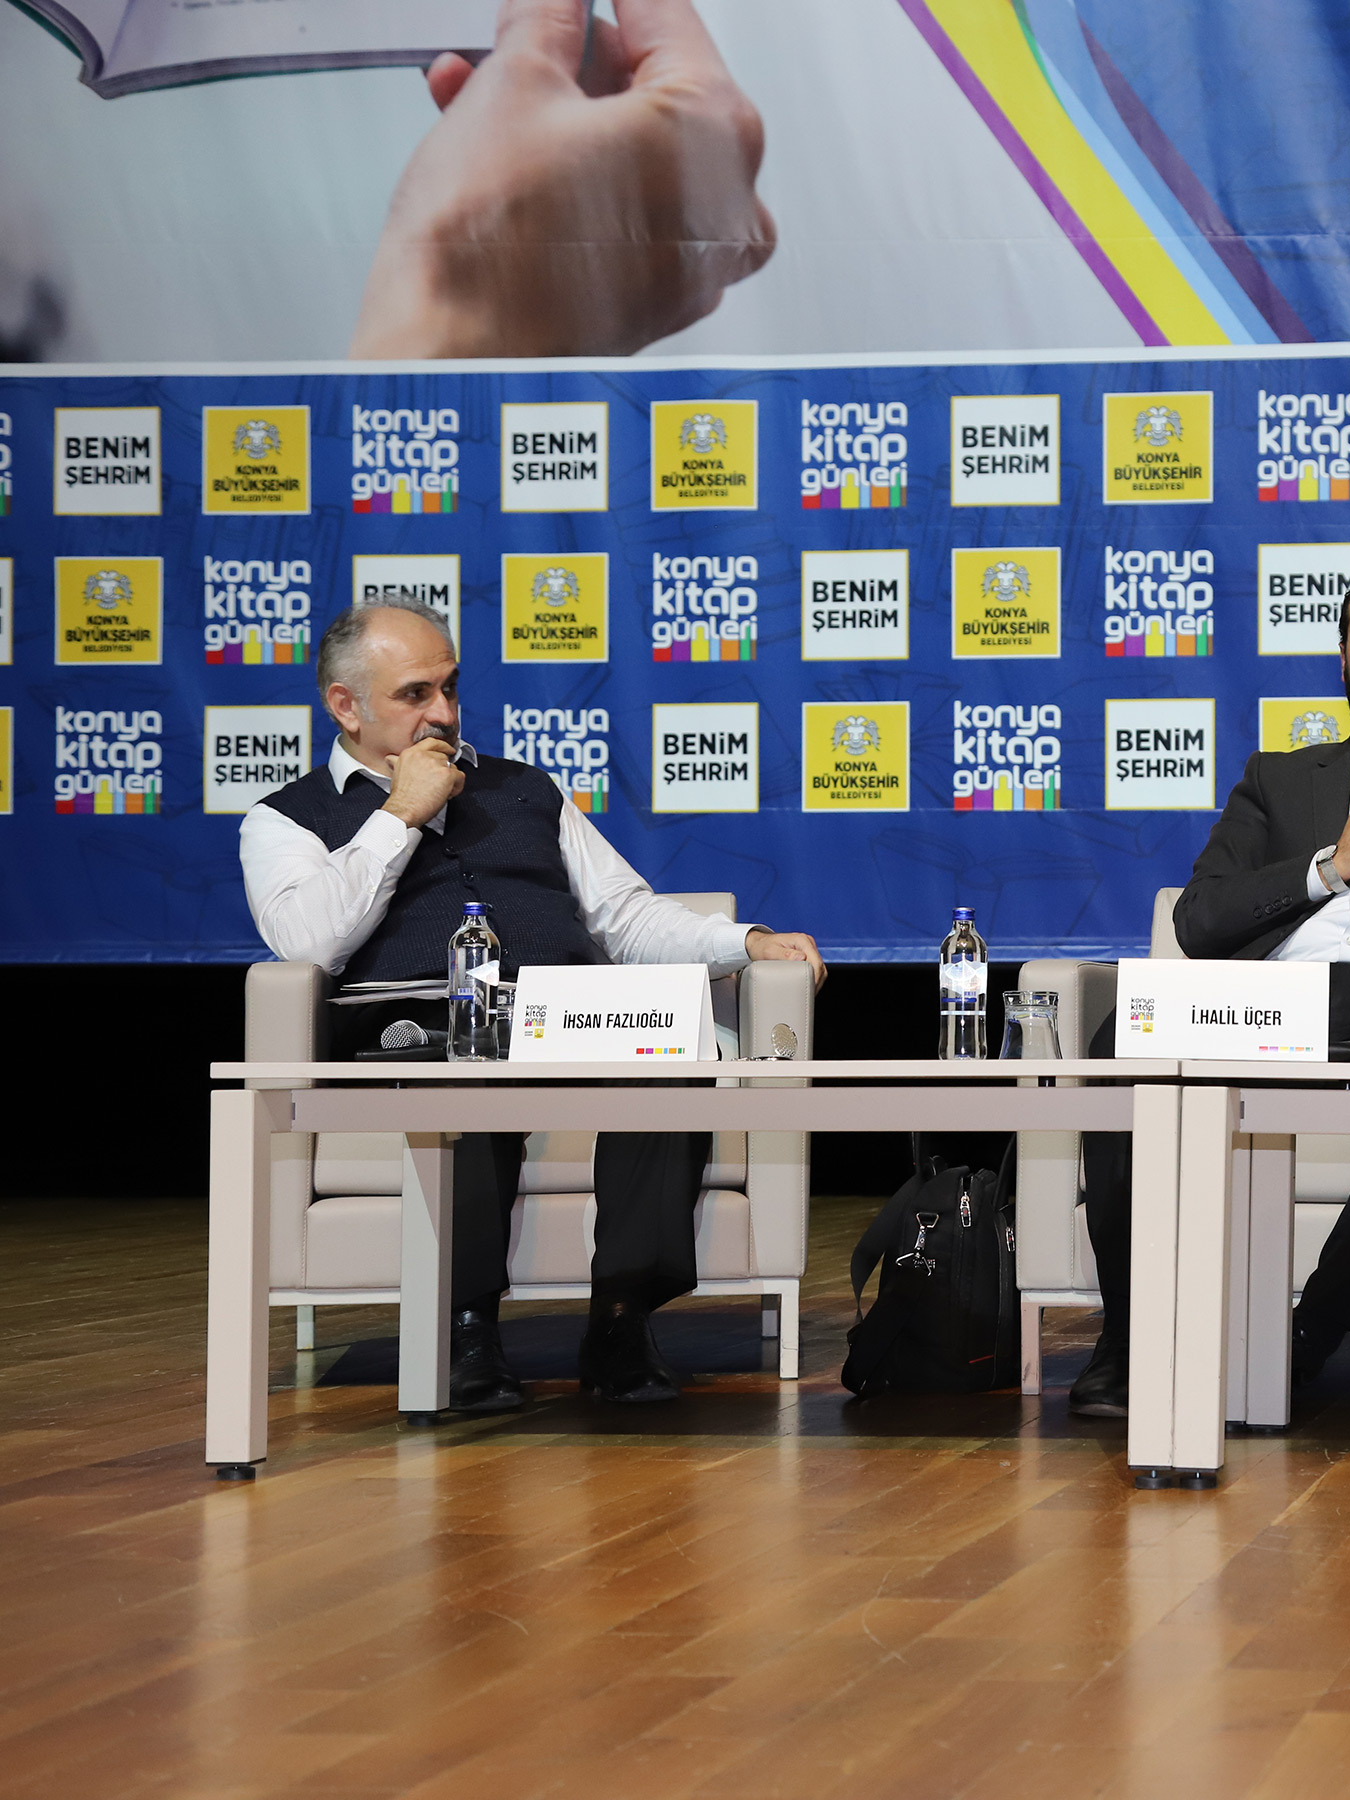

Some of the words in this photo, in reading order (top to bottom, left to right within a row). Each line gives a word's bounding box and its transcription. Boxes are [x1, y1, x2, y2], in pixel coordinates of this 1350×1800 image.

[353, 405, 458, 439] konya
[802, 400, 907, 435] konya
[353, 432, 458, 471] kitap
[802, 427, 907, 467] kitap
[1137, 452, 1180, 463] KONYA
[236, 465, 278, 476] KONYA
[662, 471, 746, 488] BÜYÜKŞEHİR
[683, 460, 723, 470] KONYA
[802, 462, 907, 496] günleri
[1114, 466, 1202, 481] BÜYÜKŞEHİR
[213, 476, 299, 492] BÜYÜKŞEHİR
[353, 467, 458, 500] günleri
[205, 556, 310, 591] konya
[653, 553, 758, 587] konya
[1105, 546, 1213, 581] konya
[205, 584, 310, 623] kitap
[653, 580, 758, 619] kitap
[1105, 574, 1213, 614] kitap
[87, 616, 128, 625] KONYA
[535, 613, 576, 623] KONYA
[963, 619, 1049, 636] BÜYÜKŞEHİR
[985, 607, 1027, 618] KONYA
[1105, 609, 1213, 643] günleri
[65, 626, 150, 642] BÜYÜKŞEHİR
[205, 619, 310, 651] günleri
[512, 624, 597, 640] BÜYÜKŞEHİR
[653, 615, 758, 648] günleri
[56, 707, 161, 741] konya
[503, 703, 609, 740] konya
[954, 701, 1061, 736] konya
[56, 734, 161, 773] kitap
[503, 732, 609, 772] kitap
[954, 728, 1061, 768] kitap
[547, 767, 609, 792] leri
[813, 773, 899, 789] BÜYÜKŞEHİR
[835, 762, 877, 771] KONYA
[954, 763, 1061, 797] günleri
[56, 769, 161, 800] günleri
[563, 1010, 602, 1029] İHSAN
[605, 1009, 674, 1029] FAZLIOĞLU
[1191, 1005, 1239, 1025] İ.HALİL
[1244, 1006, 1282, 1030] ÜÇER
